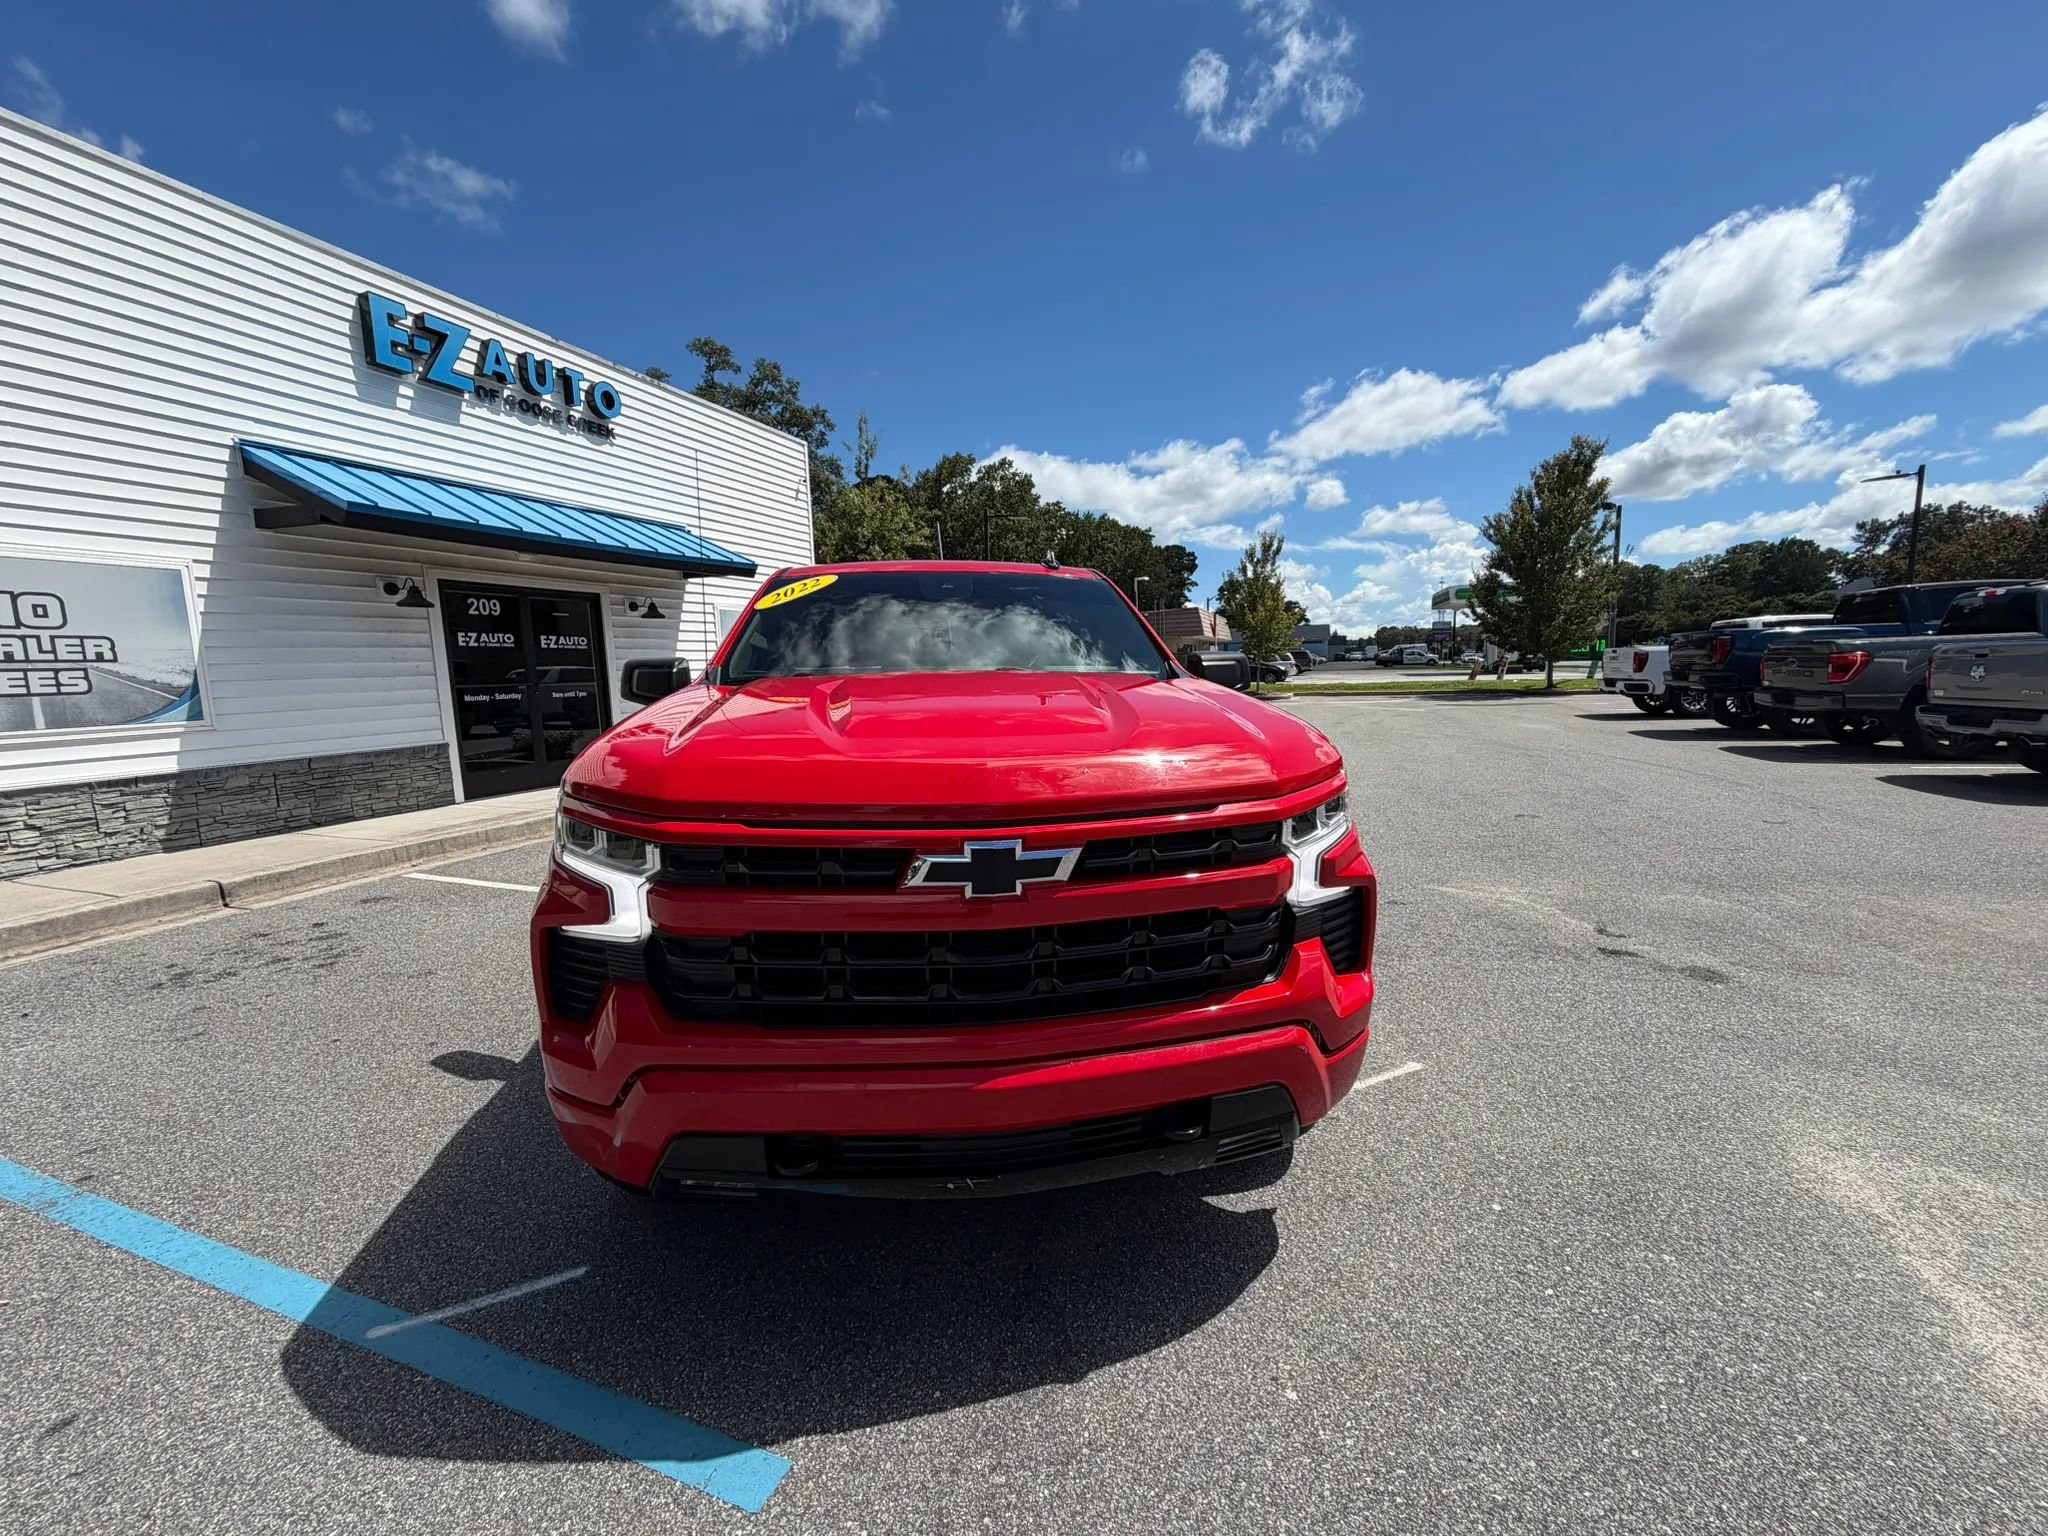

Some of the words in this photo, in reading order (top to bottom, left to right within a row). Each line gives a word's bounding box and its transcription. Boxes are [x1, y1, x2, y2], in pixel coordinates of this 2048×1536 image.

[359, 290, 477, 394] E-Z
[475, 338, 622, 419] AUTO
[475, 385, 500, 403] OF
[567, 414, 617, 440] CREEK
[771, 578, 821, 605] 2022
[467, 598, 501, 616] 209
[457, 632, 479, 647] E-Z
[480, 633, 515, 643] AUTO
[540, 635, 559, 648] E-Z
[558, 636, 588, 646] AUTO
[464, 694, 490, 702] Monday
[495, 692, 522, 700] Saturday
